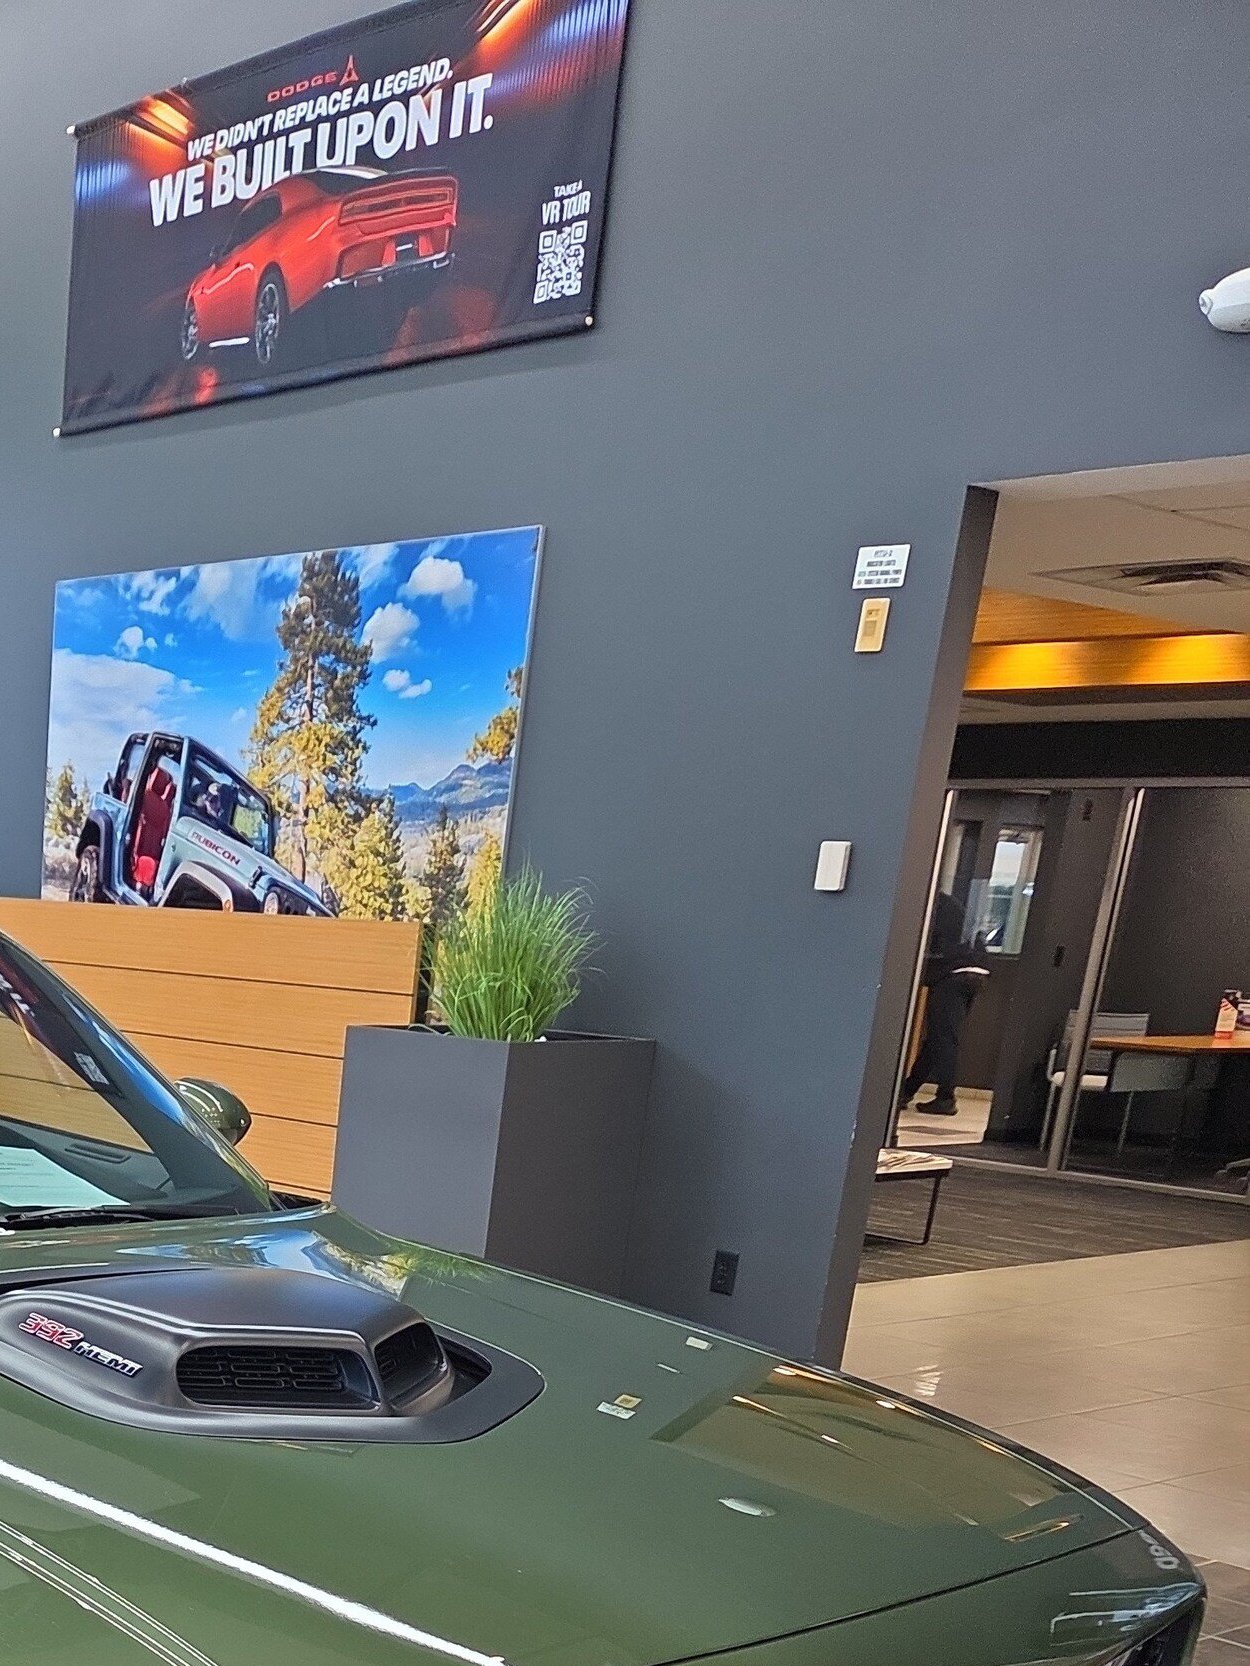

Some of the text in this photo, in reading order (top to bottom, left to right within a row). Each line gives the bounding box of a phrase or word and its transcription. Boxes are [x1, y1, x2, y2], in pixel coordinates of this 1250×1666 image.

[267, 71, 338, 102] DODGE
[187, 57, 453, 161] WE DIDN'T REPLACE A LEGEND.
[150, 72, 494, 227] WE BUILT UPON IT.
[542, 190, 591, 226] VR TOUR
[554, 182, 578, 198] TAKE
[191, 831, 241, 865] RUBICON
[18, 1312, 144, 1377] 392 HEMI
